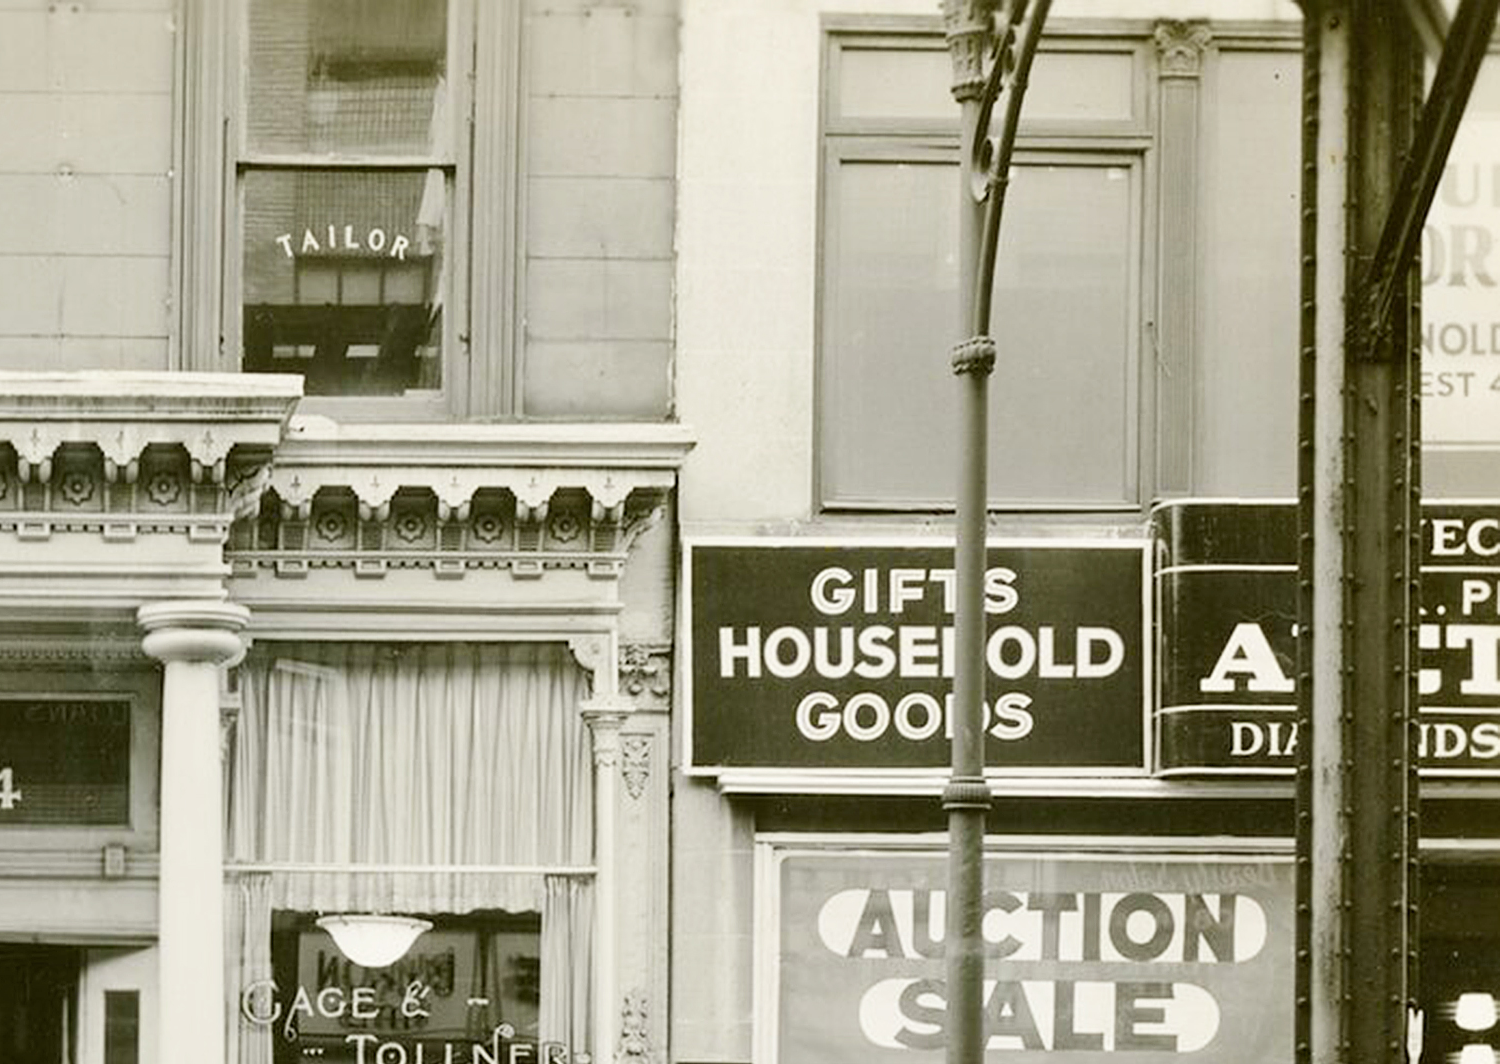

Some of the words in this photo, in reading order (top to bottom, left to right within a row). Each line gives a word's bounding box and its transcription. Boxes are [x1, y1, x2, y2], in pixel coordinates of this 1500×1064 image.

[276, 225, 410, 261] TAILOR
[719, 625, 1126, 679] HOUSEOLD
[242, 978, 381, 1040] GAGE
[401, 980, 431, 1018] &
[894, 978, 1179, 1053] SALE
